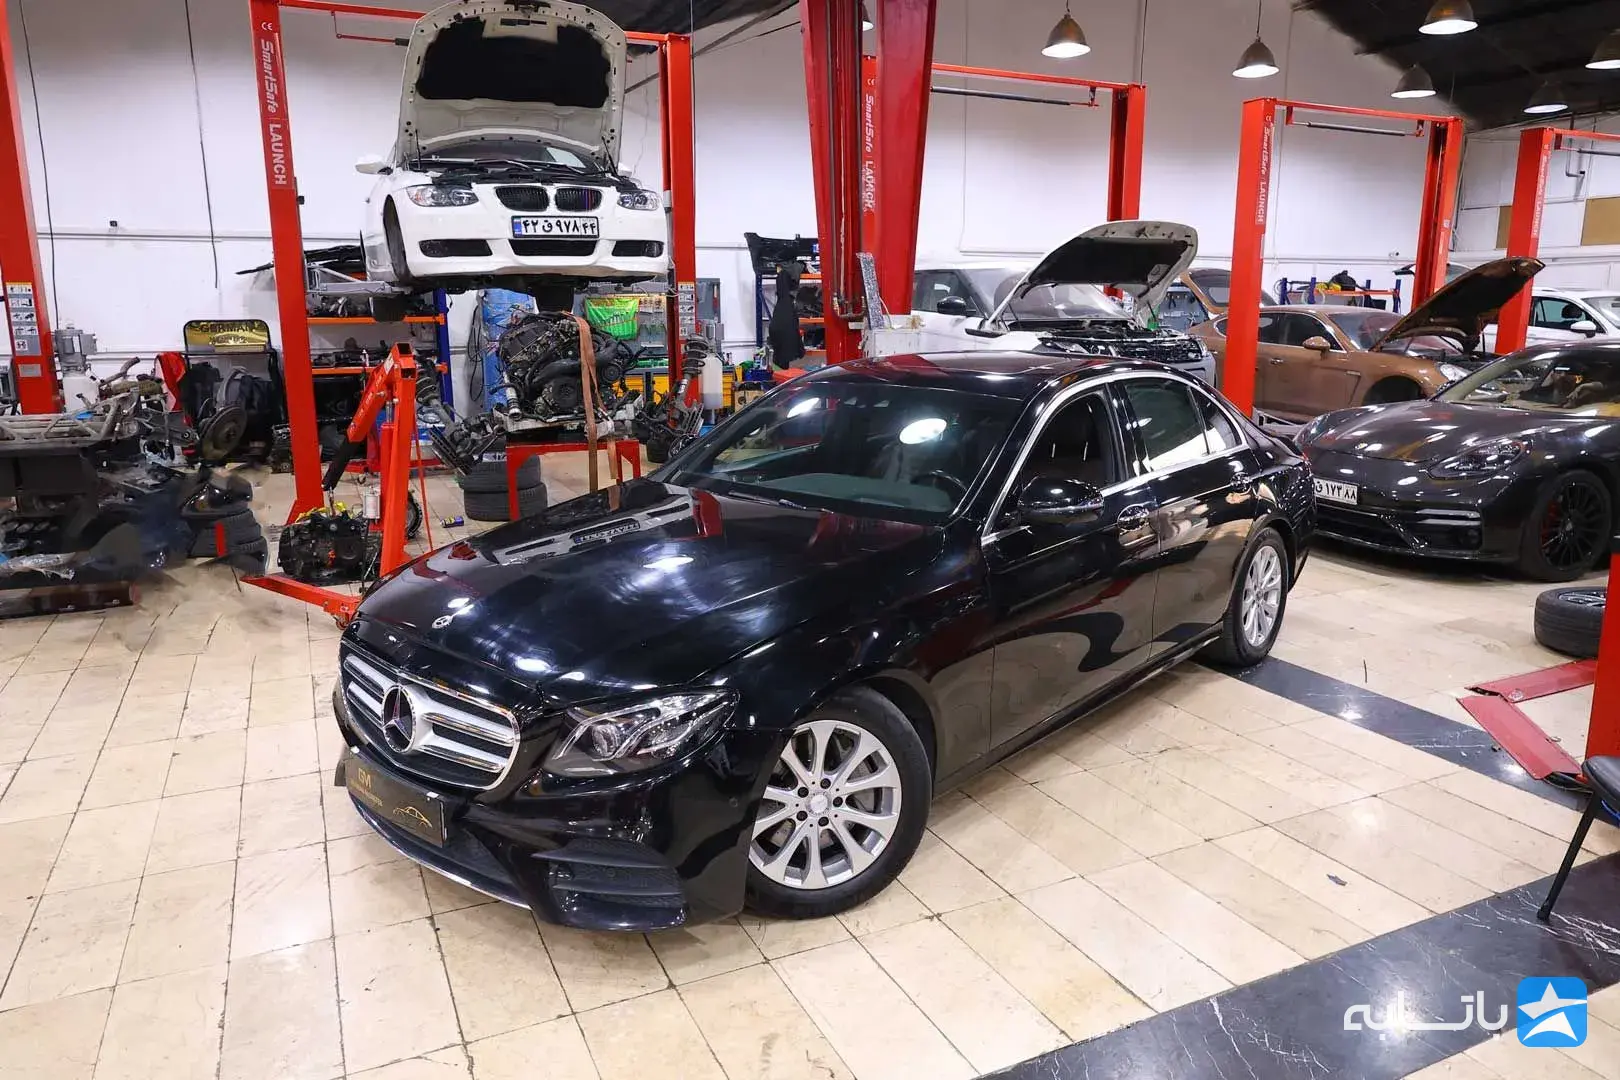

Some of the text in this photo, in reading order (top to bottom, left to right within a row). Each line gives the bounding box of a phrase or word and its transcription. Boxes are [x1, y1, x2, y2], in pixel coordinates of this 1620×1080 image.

[260, 38, 287, 185] SmartSafe LAUNCH
[864, 94, 874, 153] SmartSafe
[1257, 126, 1271, 223] SmartSafe LAUNCH
